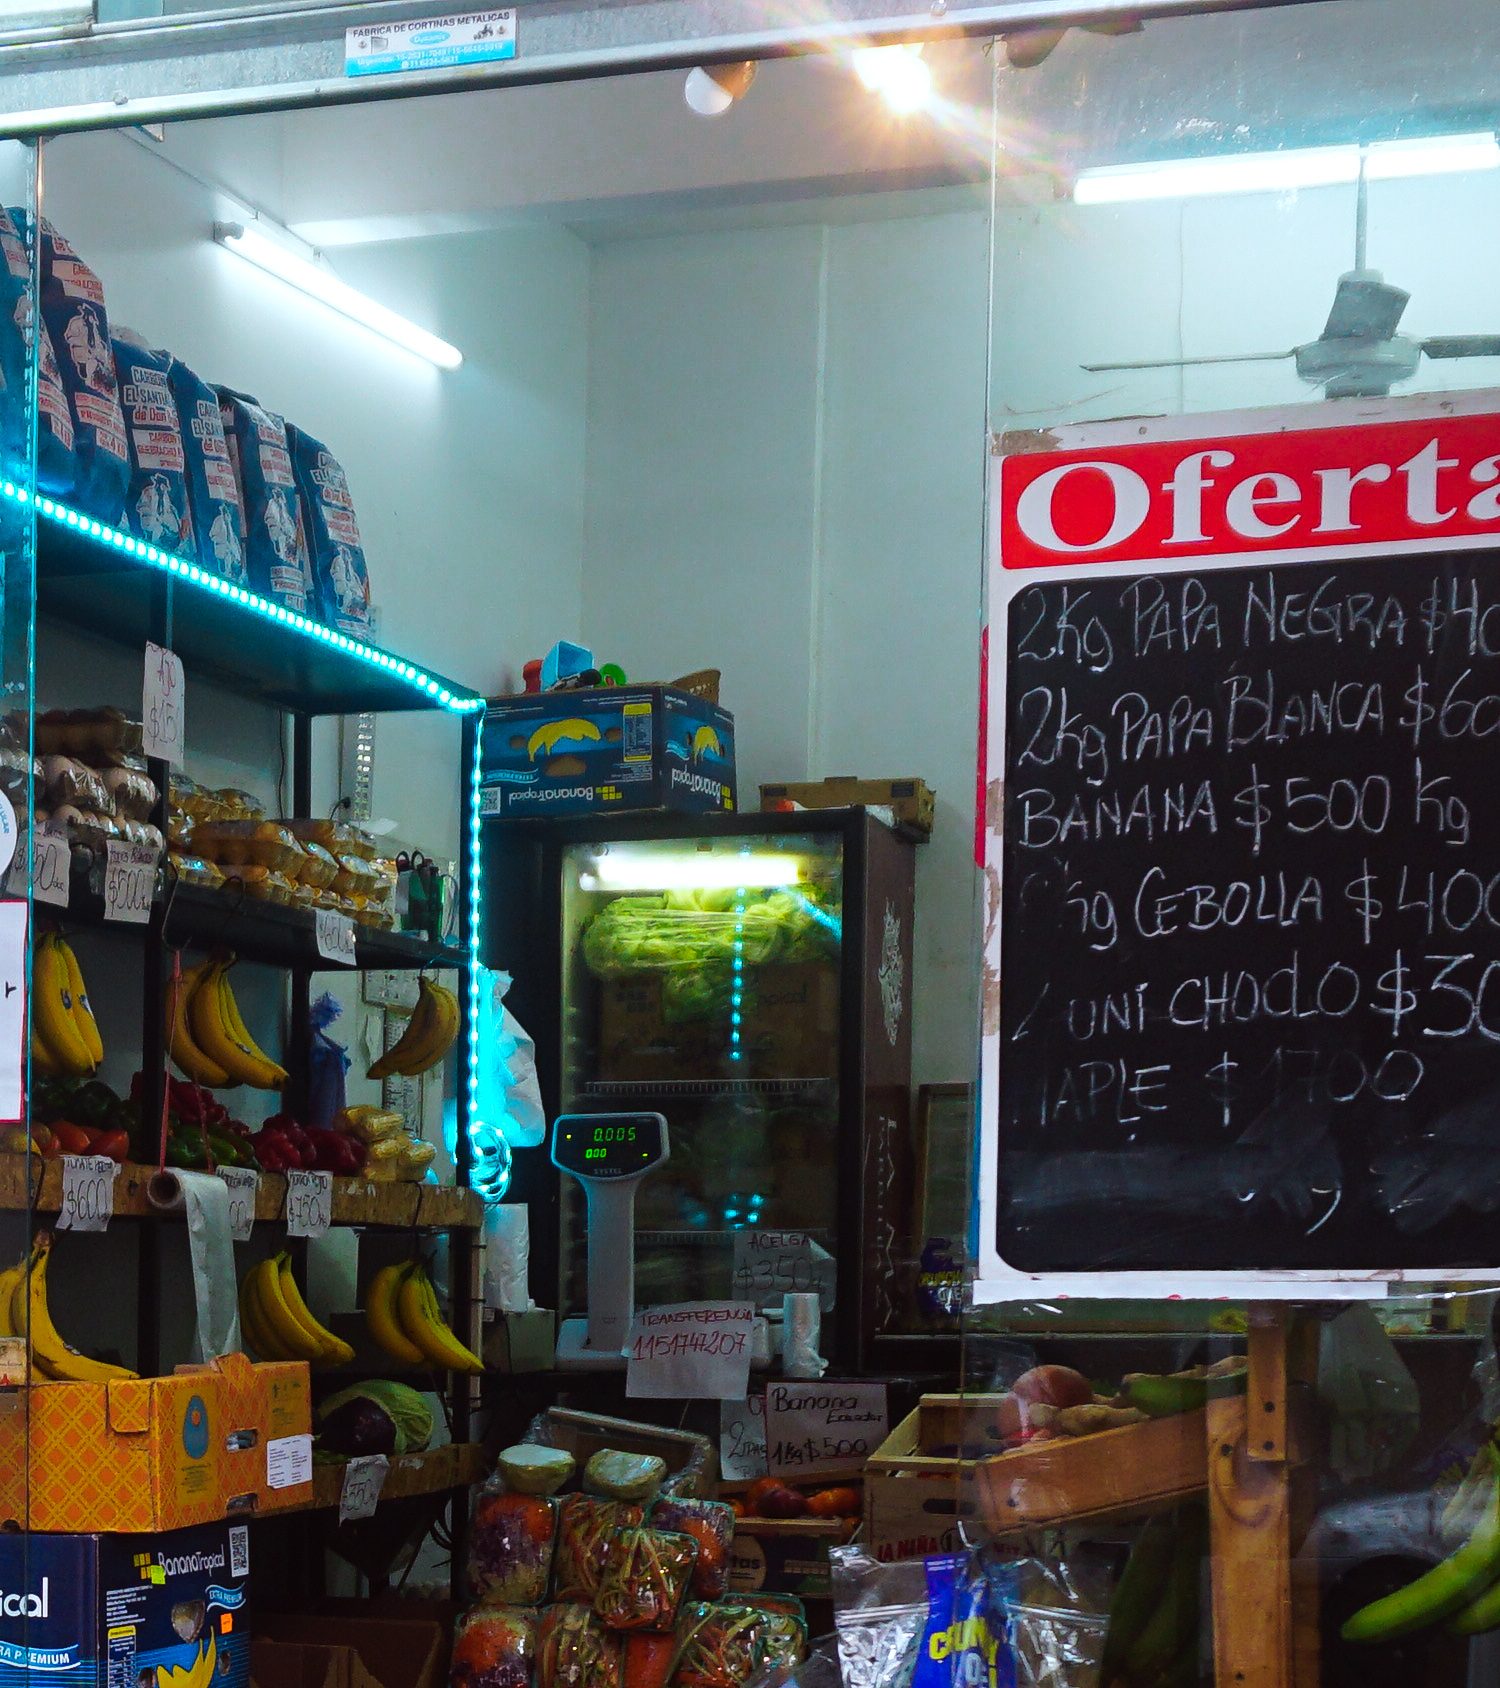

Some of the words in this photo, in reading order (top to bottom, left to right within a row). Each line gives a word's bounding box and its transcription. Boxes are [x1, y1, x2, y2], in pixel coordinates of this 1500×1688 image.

[394, 22, 406, 33] DE
[408, 18, 456, 31] CORTINAS
[1120, 576, 1221, 658] PAPA
[1244, 571, 1405, 649] NEGRA
[1112, 691, 1213, 761] PAPA
[1222, 668, 1385, 753] BLANCA
[1017, 779, 1219, 848] BANANA
[1134, 865, 1324, 939] CEBOLLA
[593, 1126, 636, 1142] 0.005
[13, 1647, 71, 1667] PEMIUM
